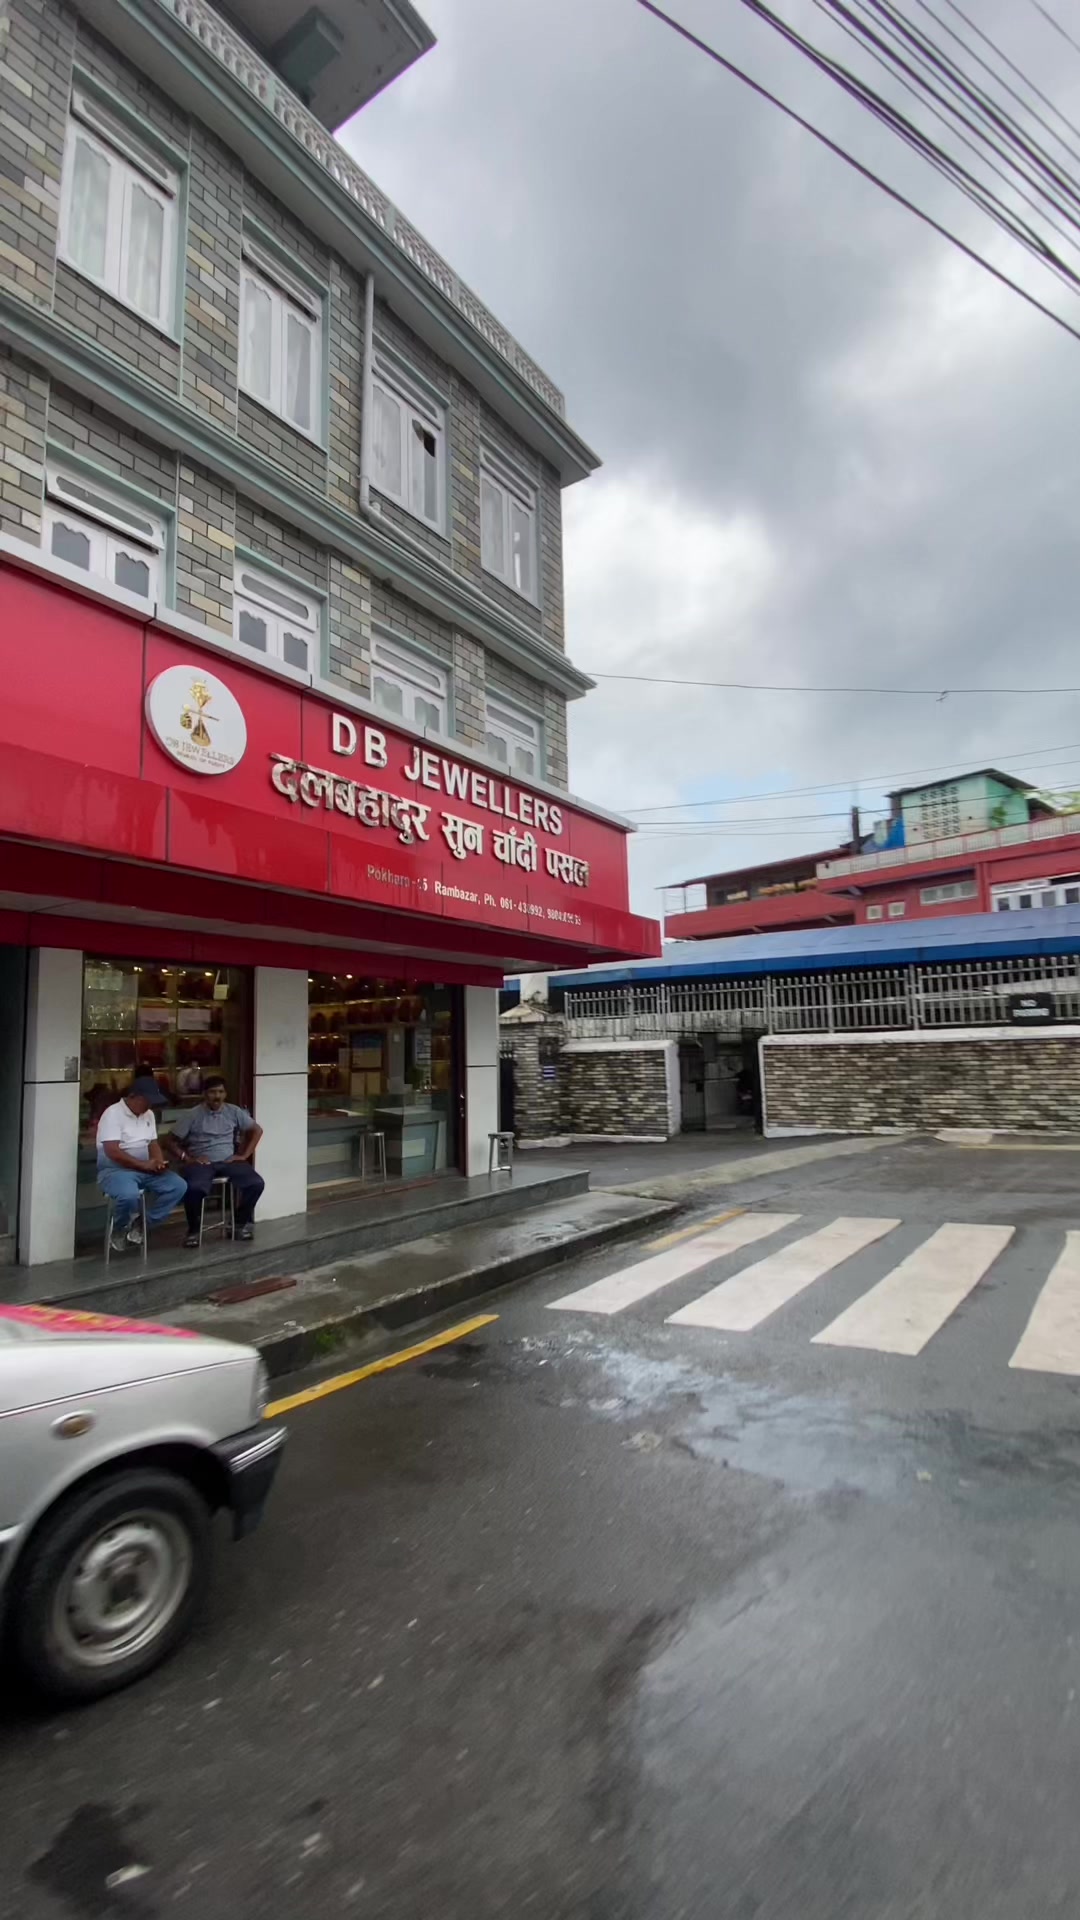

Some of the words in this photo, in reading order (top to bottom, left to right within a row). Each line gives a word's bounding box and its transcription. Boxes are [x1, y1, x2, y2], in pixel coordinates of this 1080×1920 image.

[270, 752, 432, 845] दलबहादुर
[441, 811, 484, 860] सुन
[545, 847, 590, 888] पसल
[404, 746, 563, 835] JEWELLERS
[434, 881, 480, 905] Rambazar,
[484, 893, 497, 907] Ph.
